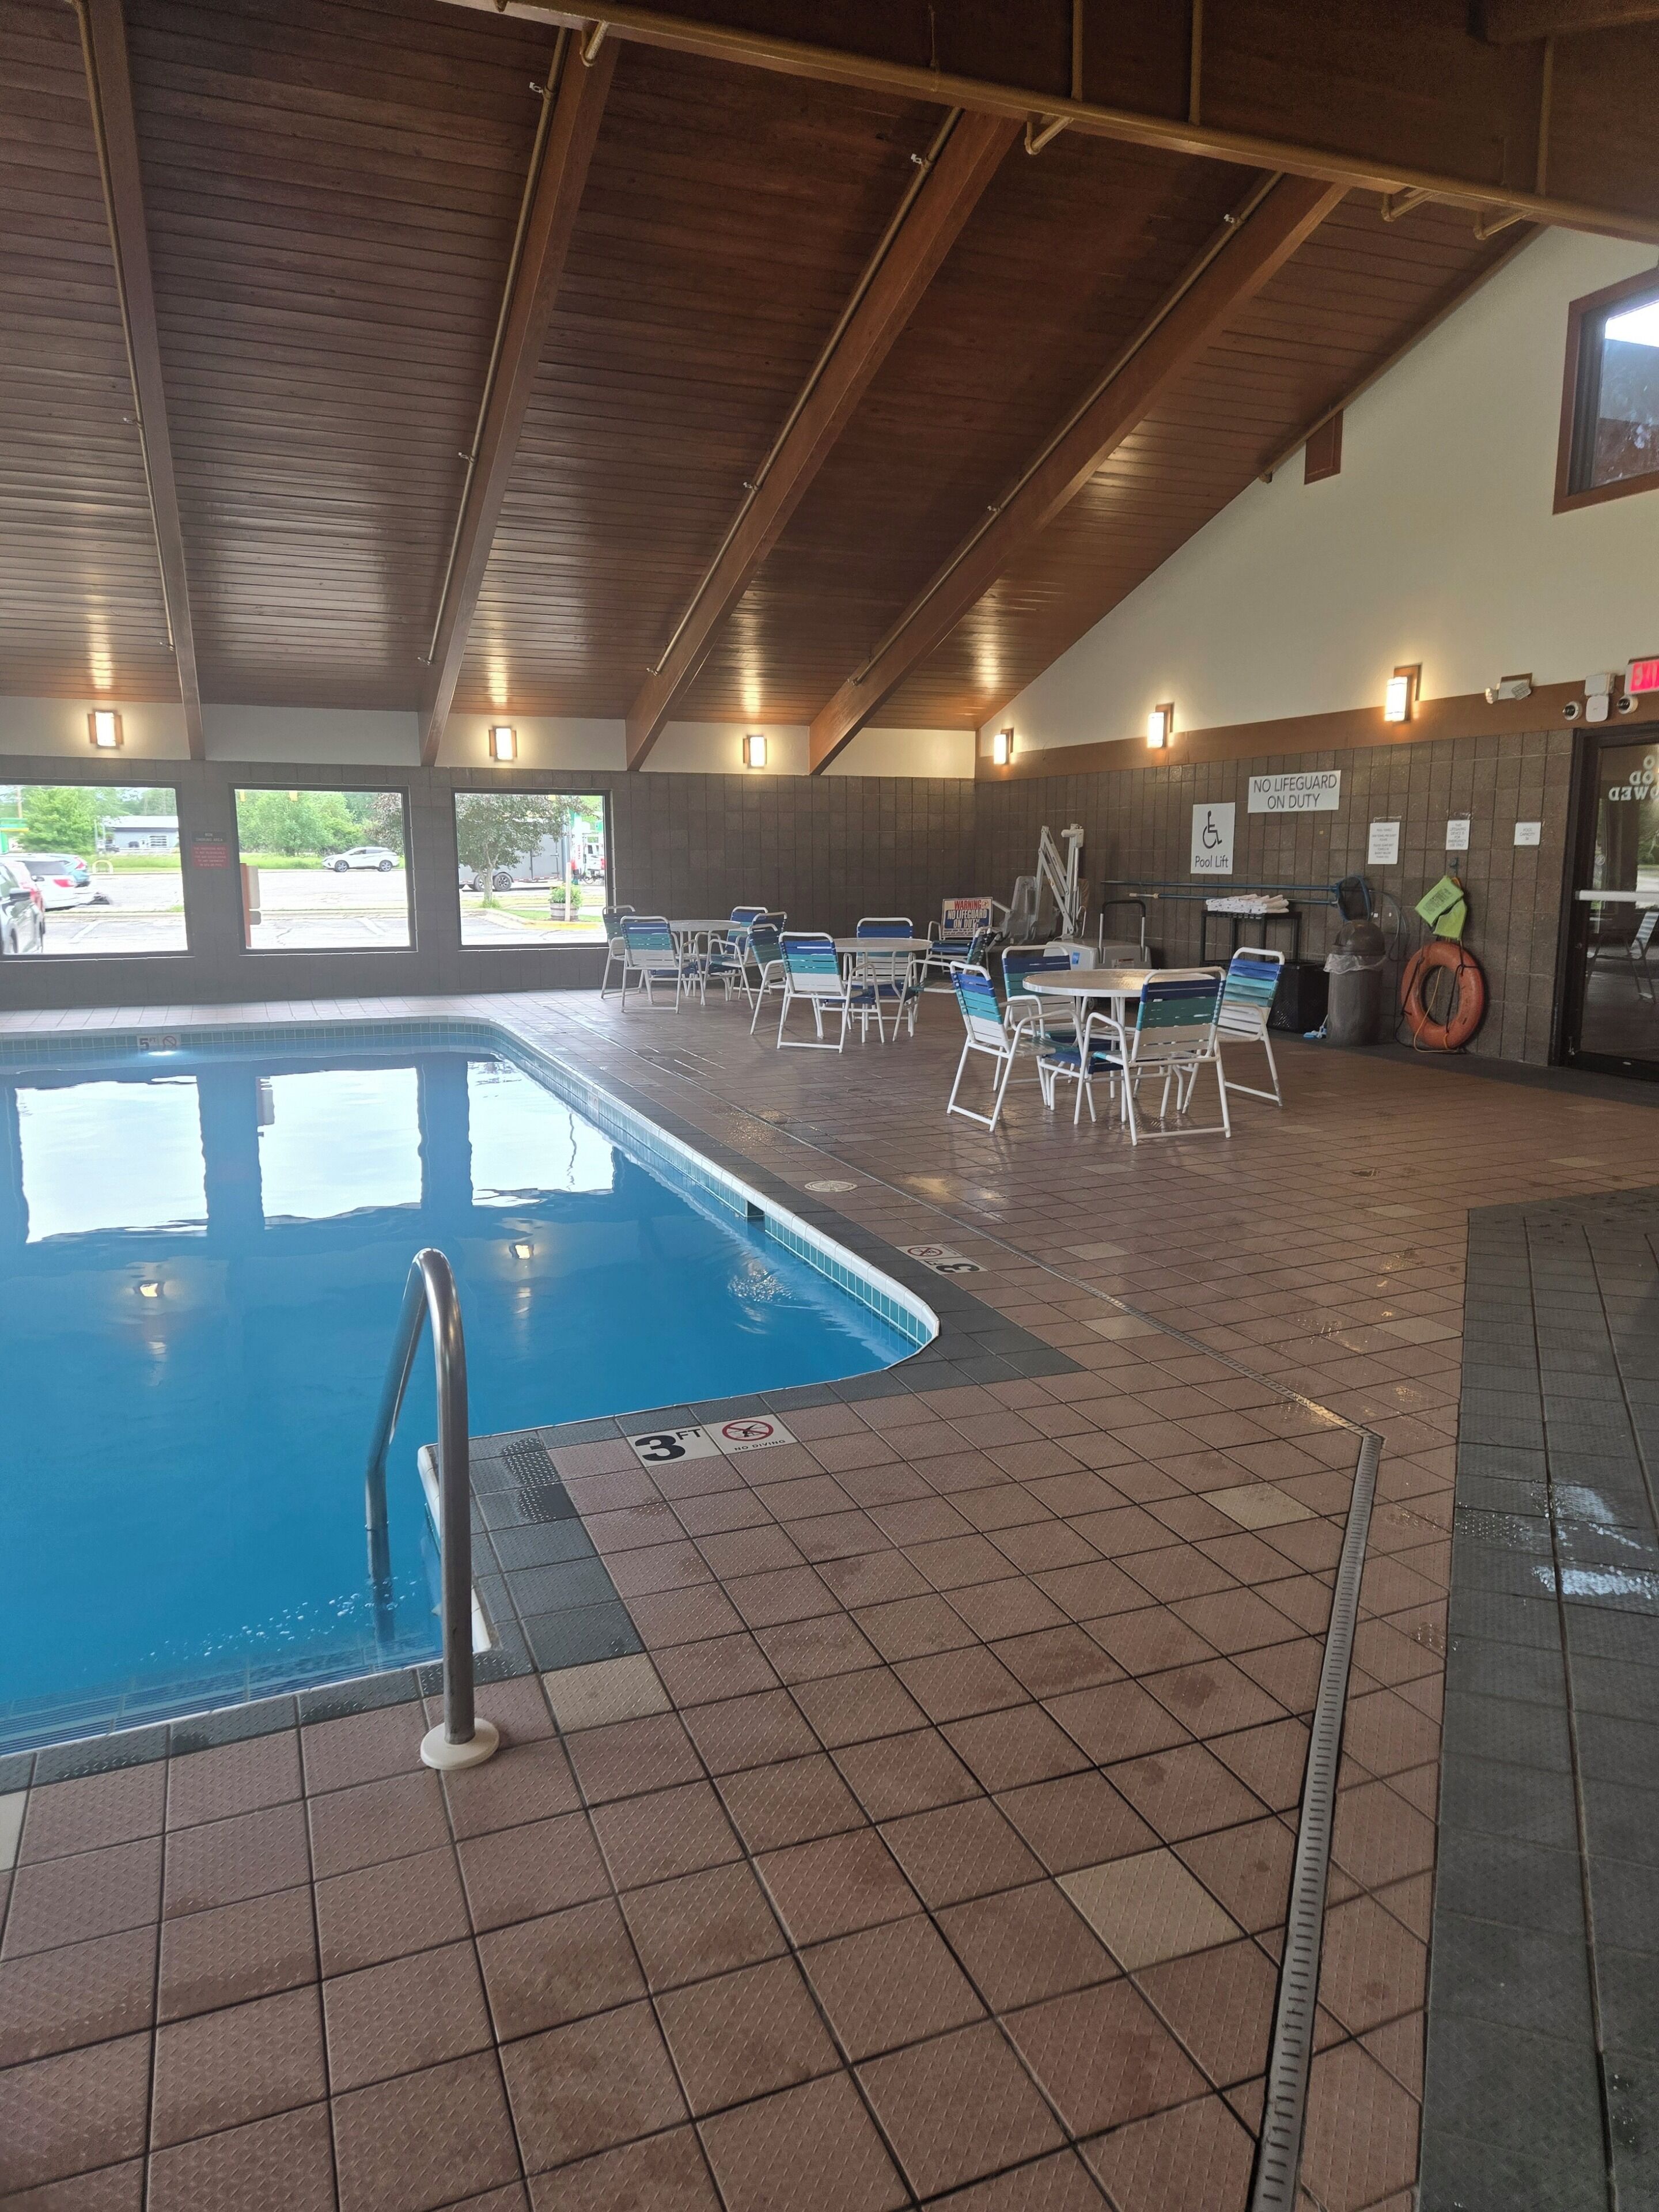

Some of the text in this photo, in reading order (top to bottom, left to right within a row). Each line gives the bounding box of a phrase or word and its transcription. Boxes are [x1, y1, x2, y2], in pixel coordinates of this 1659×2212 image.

[1253, 774, 1337, 793] NO LIFEGUARD
[1267, 793, 1320, 809] ON DUTY
[1195, 855, 1229, 868] Pool Lift
[955, 900, 982, 910] WARNING
[948, 909, 987, 919] NO LIFEGUARD
[953, 919, 962, 928] ON
[936, 1263, 980, 1273] 3
[634, 1429, 701, 1461] 3 FT
[752, 1440, 786, 1448] DIVING
